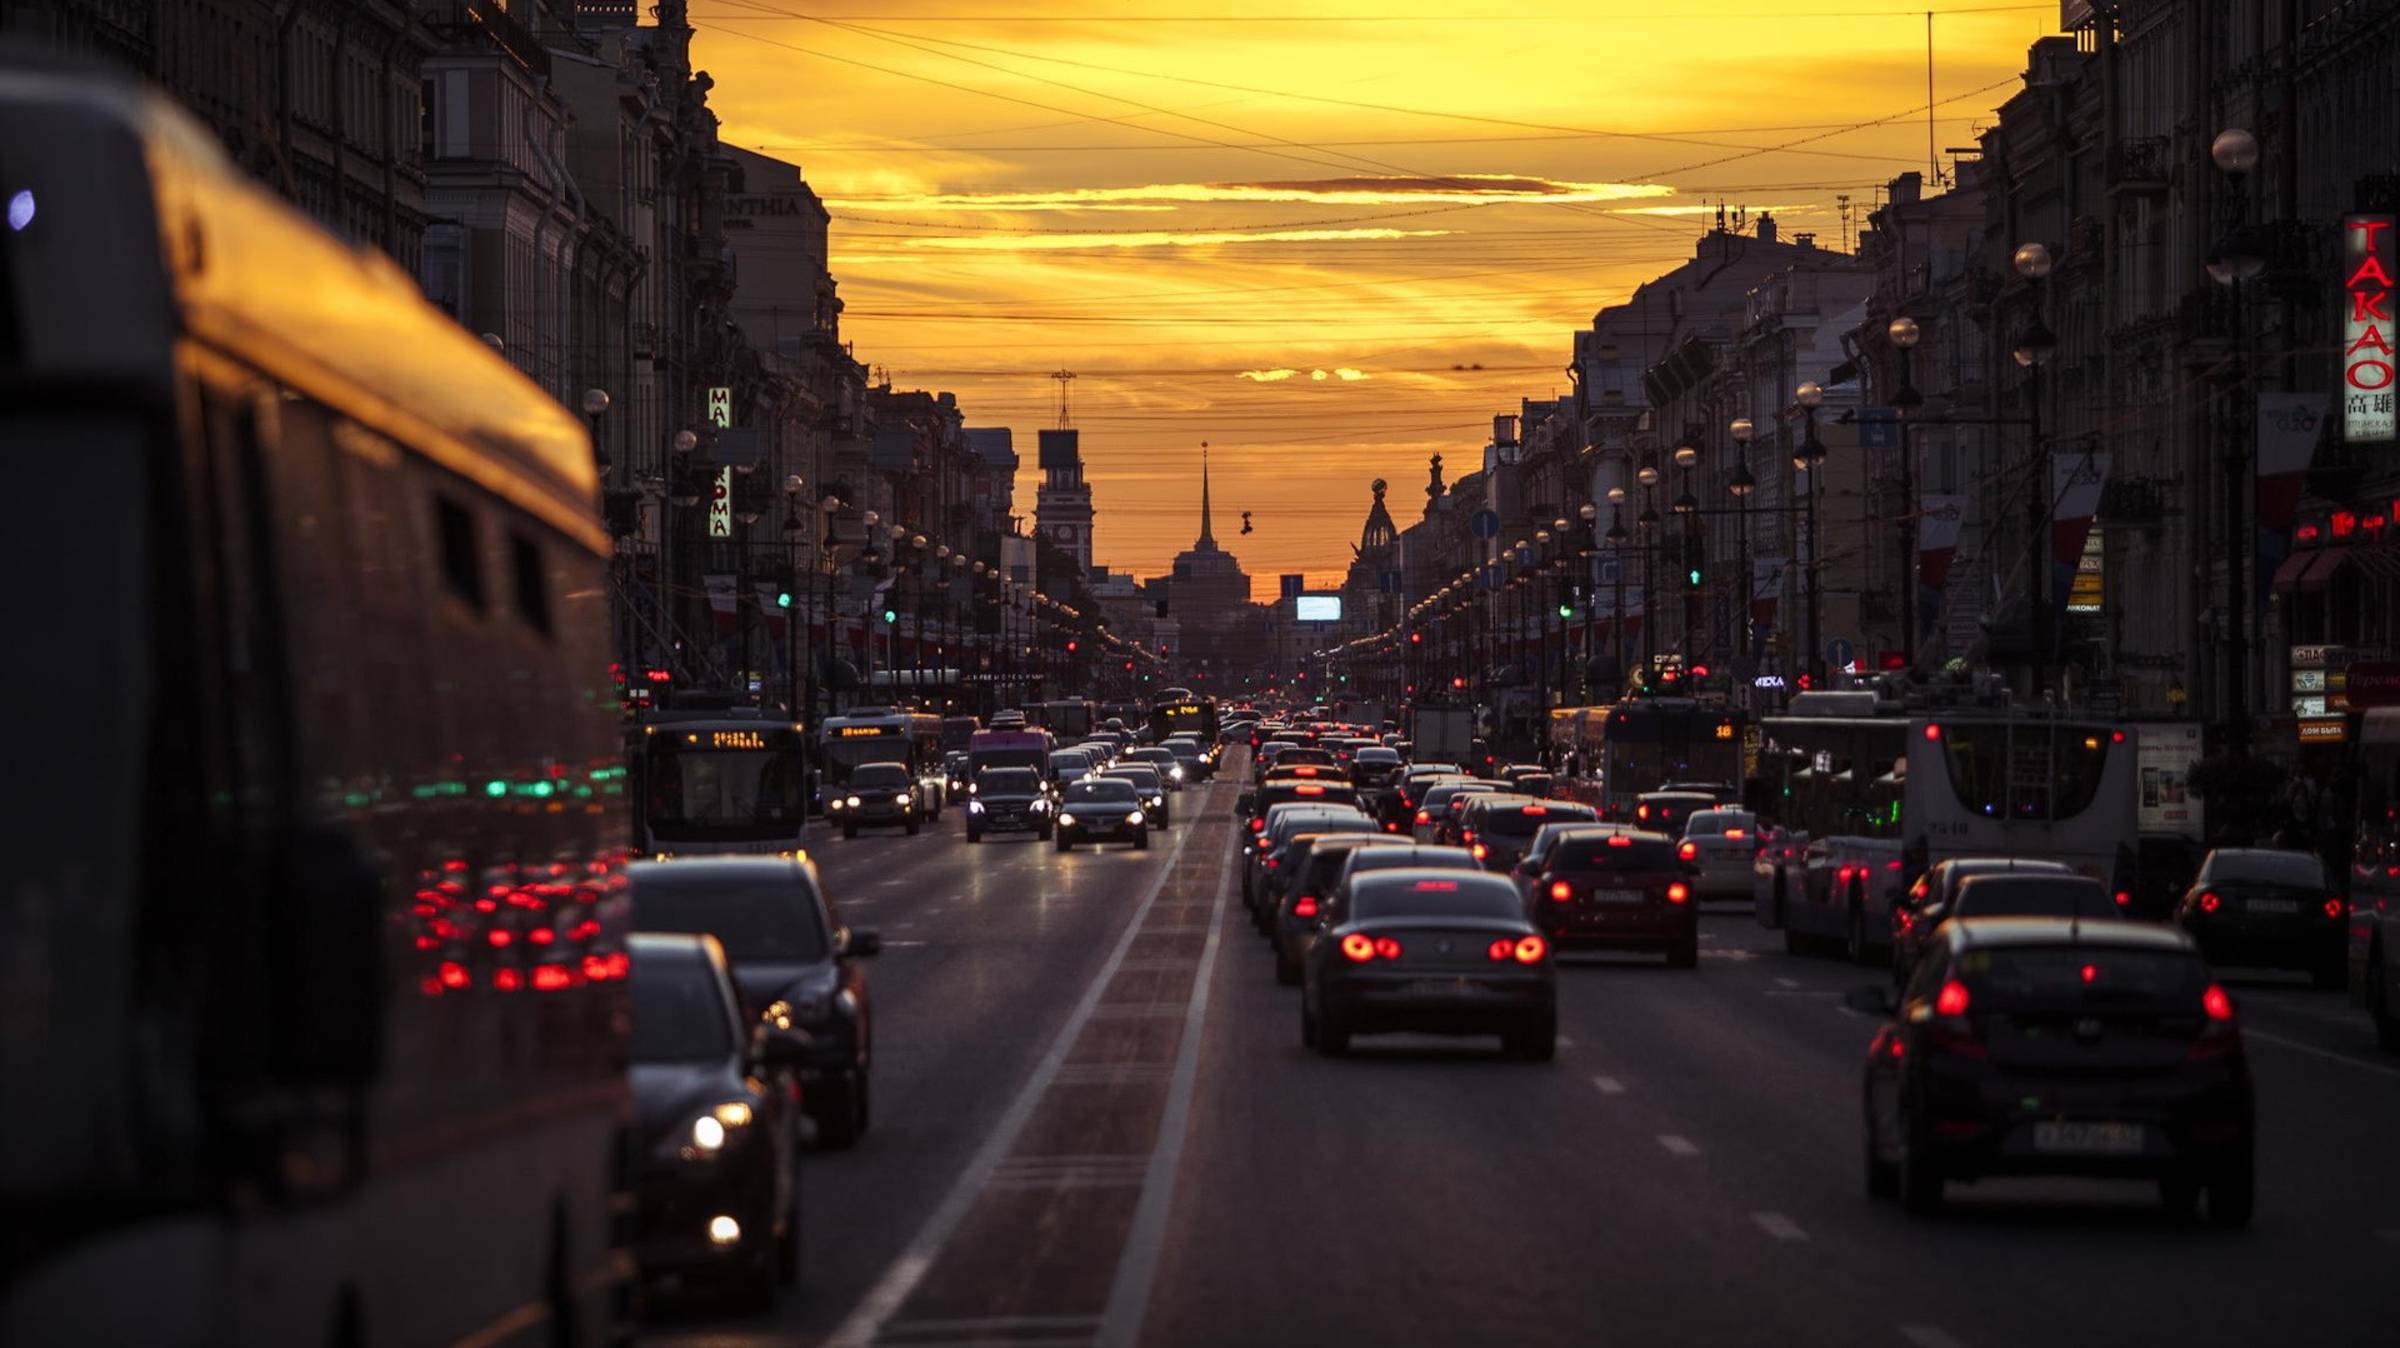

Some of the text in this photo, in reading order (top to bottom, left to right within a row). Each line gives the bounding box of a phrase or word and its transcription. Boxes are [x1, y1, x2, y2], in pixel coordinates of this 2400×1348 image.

[727, 198, 800, 215] NTHIA
[2346, 219, 2394, 390] TAKAO
[2348, 394, 2393, 414] 高雄
